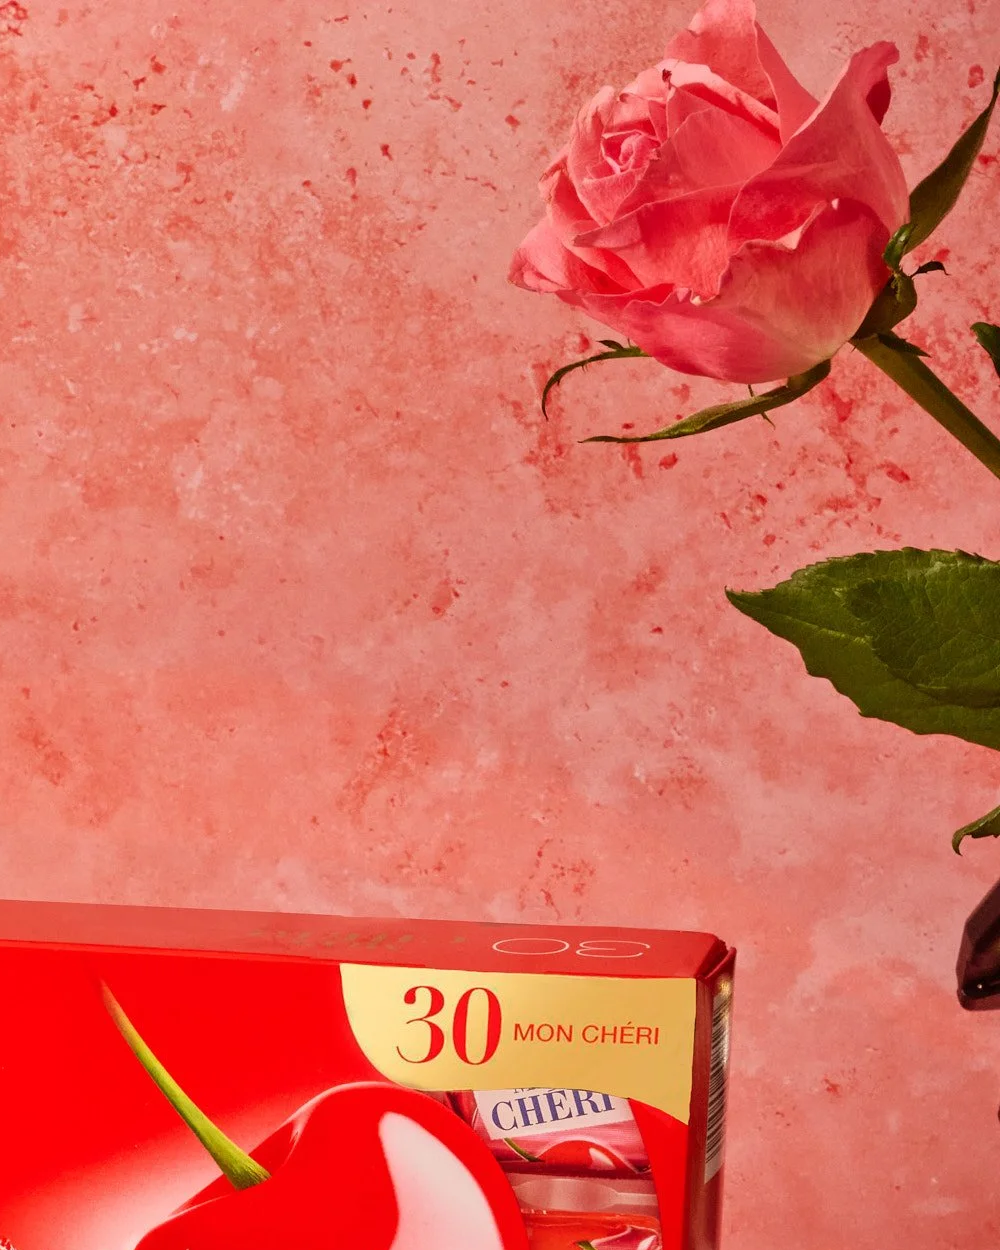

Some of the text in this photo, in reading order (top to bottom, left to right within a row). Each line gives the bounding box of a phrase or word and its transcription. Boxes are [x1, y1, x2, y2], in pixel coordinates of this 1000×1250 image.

[396, 985, 660, 1065] 30 MON CHÉRI
